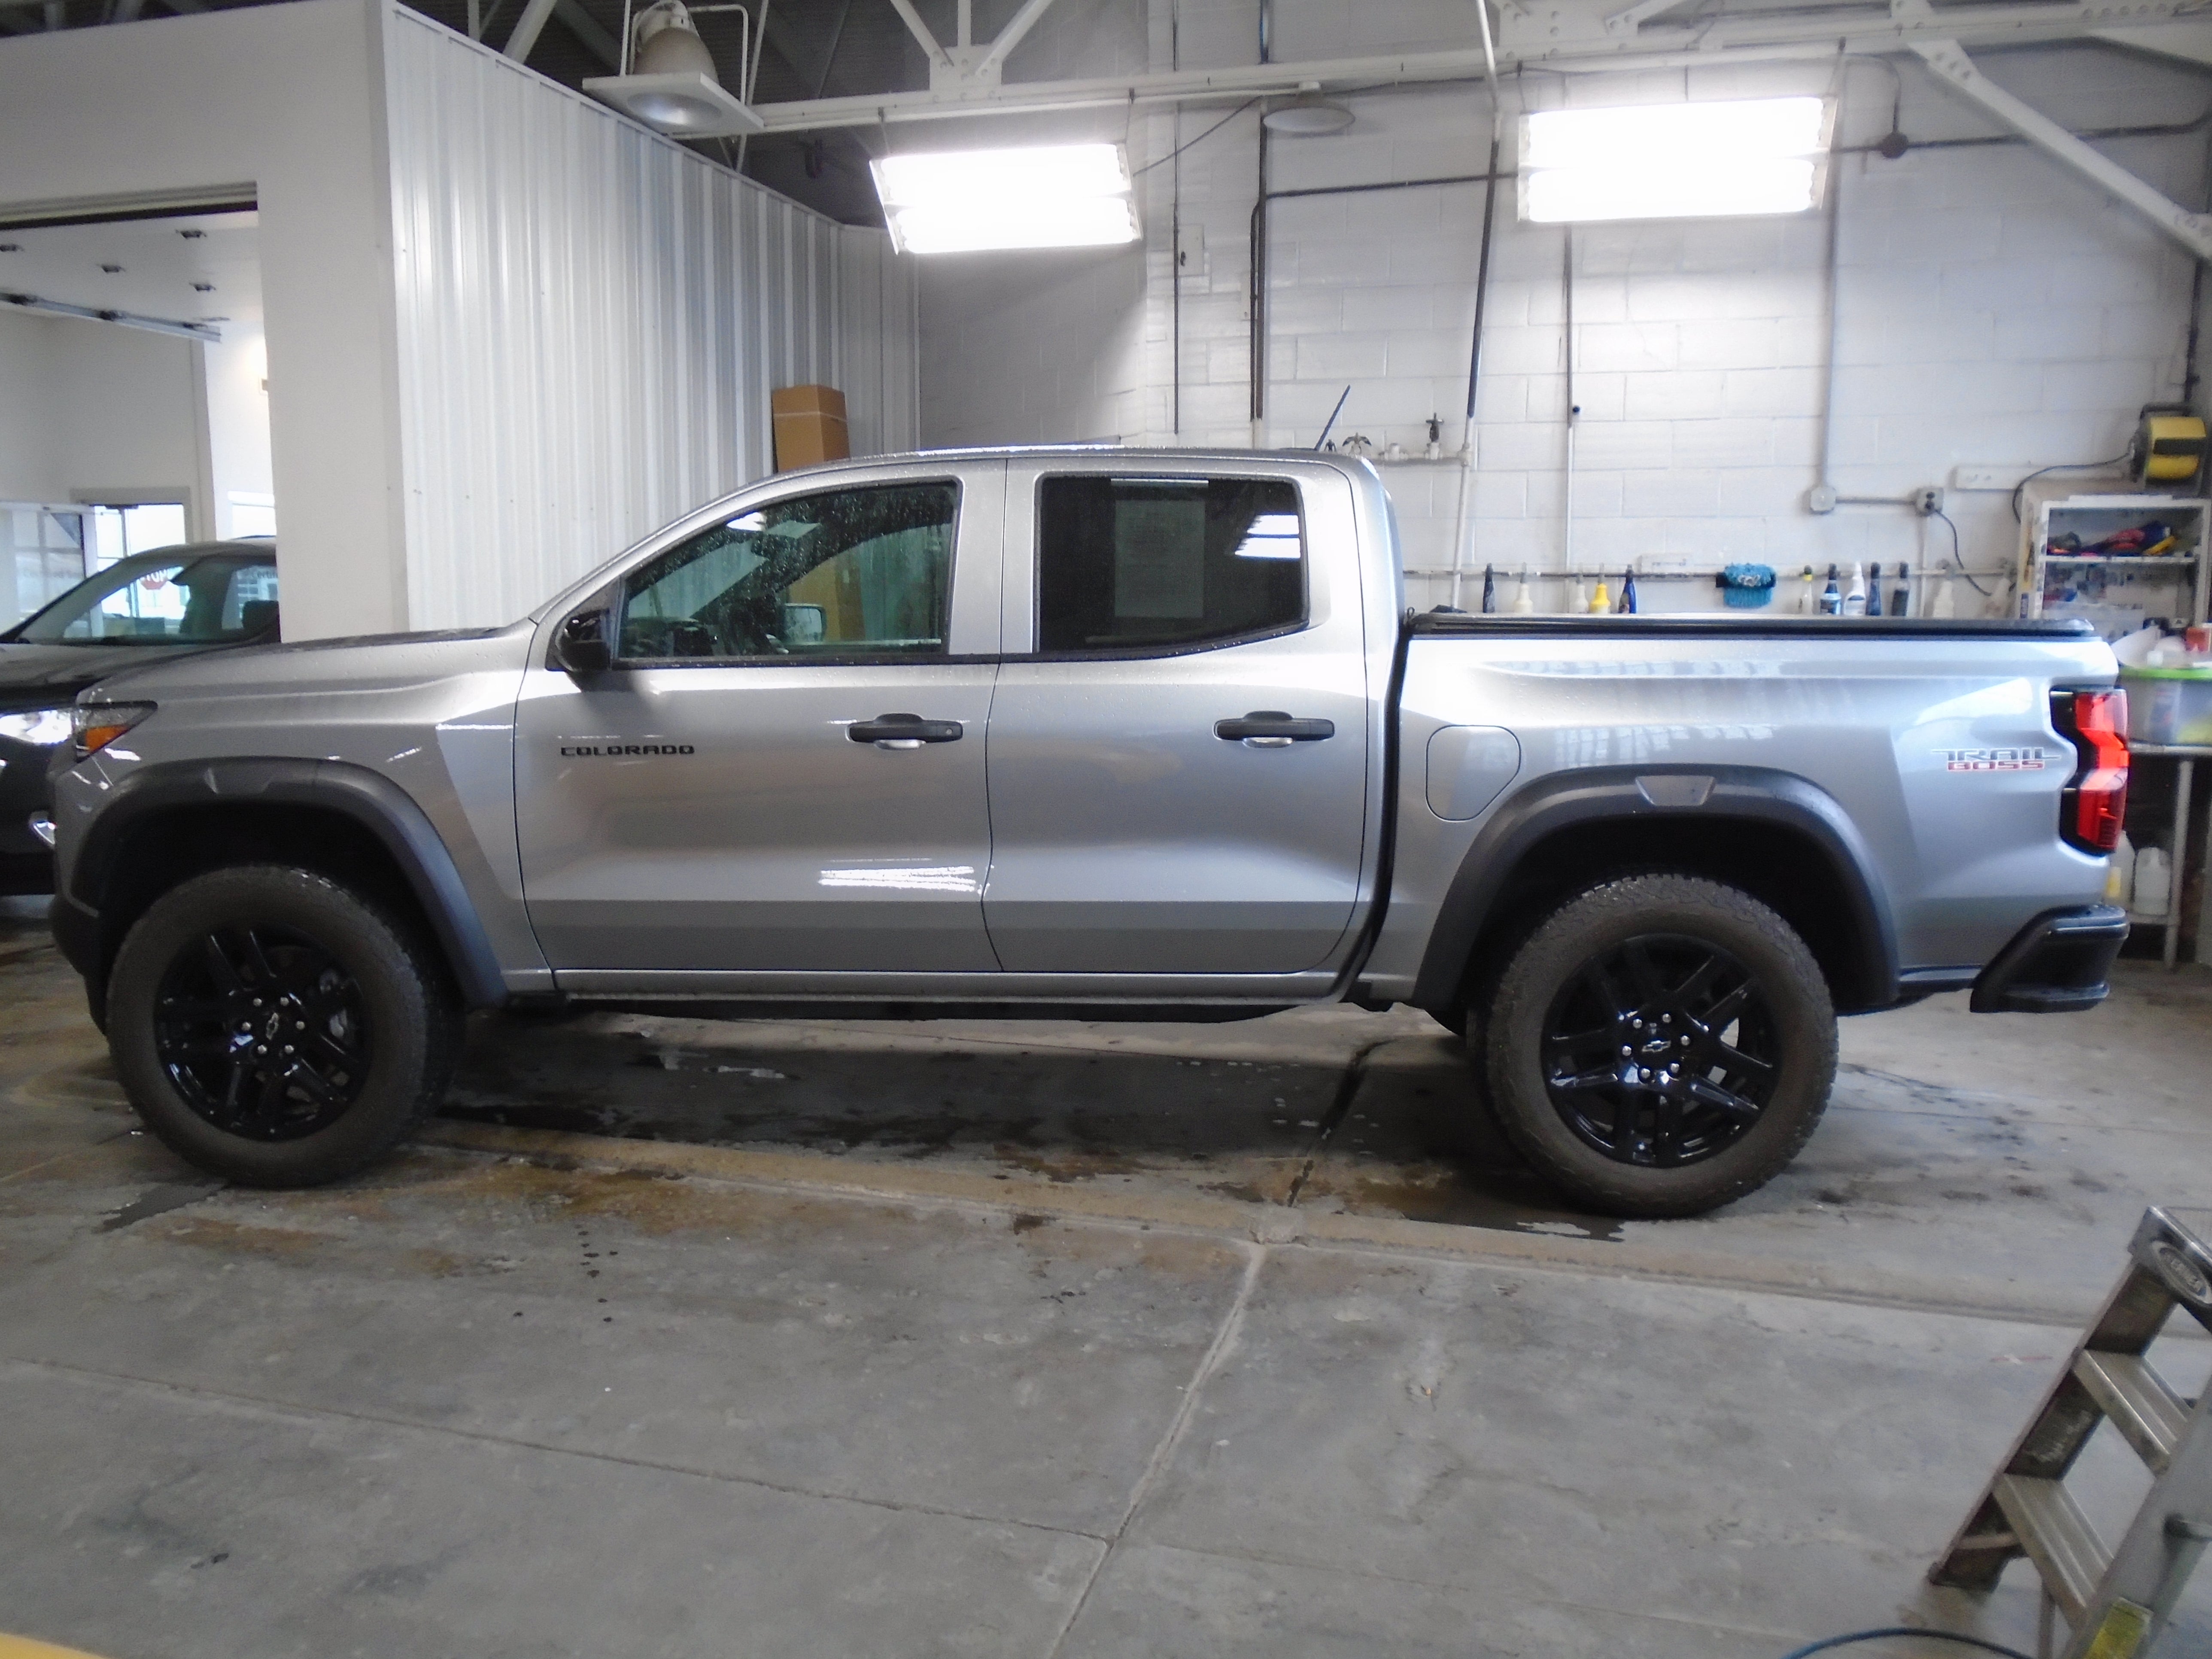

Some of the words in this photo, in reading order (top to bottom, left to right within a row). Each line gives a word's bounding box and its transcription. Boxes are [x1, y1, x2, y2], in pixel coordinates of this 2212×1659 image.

[561, 745, 695, 756] COLORADO
[1932, 747, 2060, 761] TRAIL
[1947, 760, 2045, 771] BOSS
